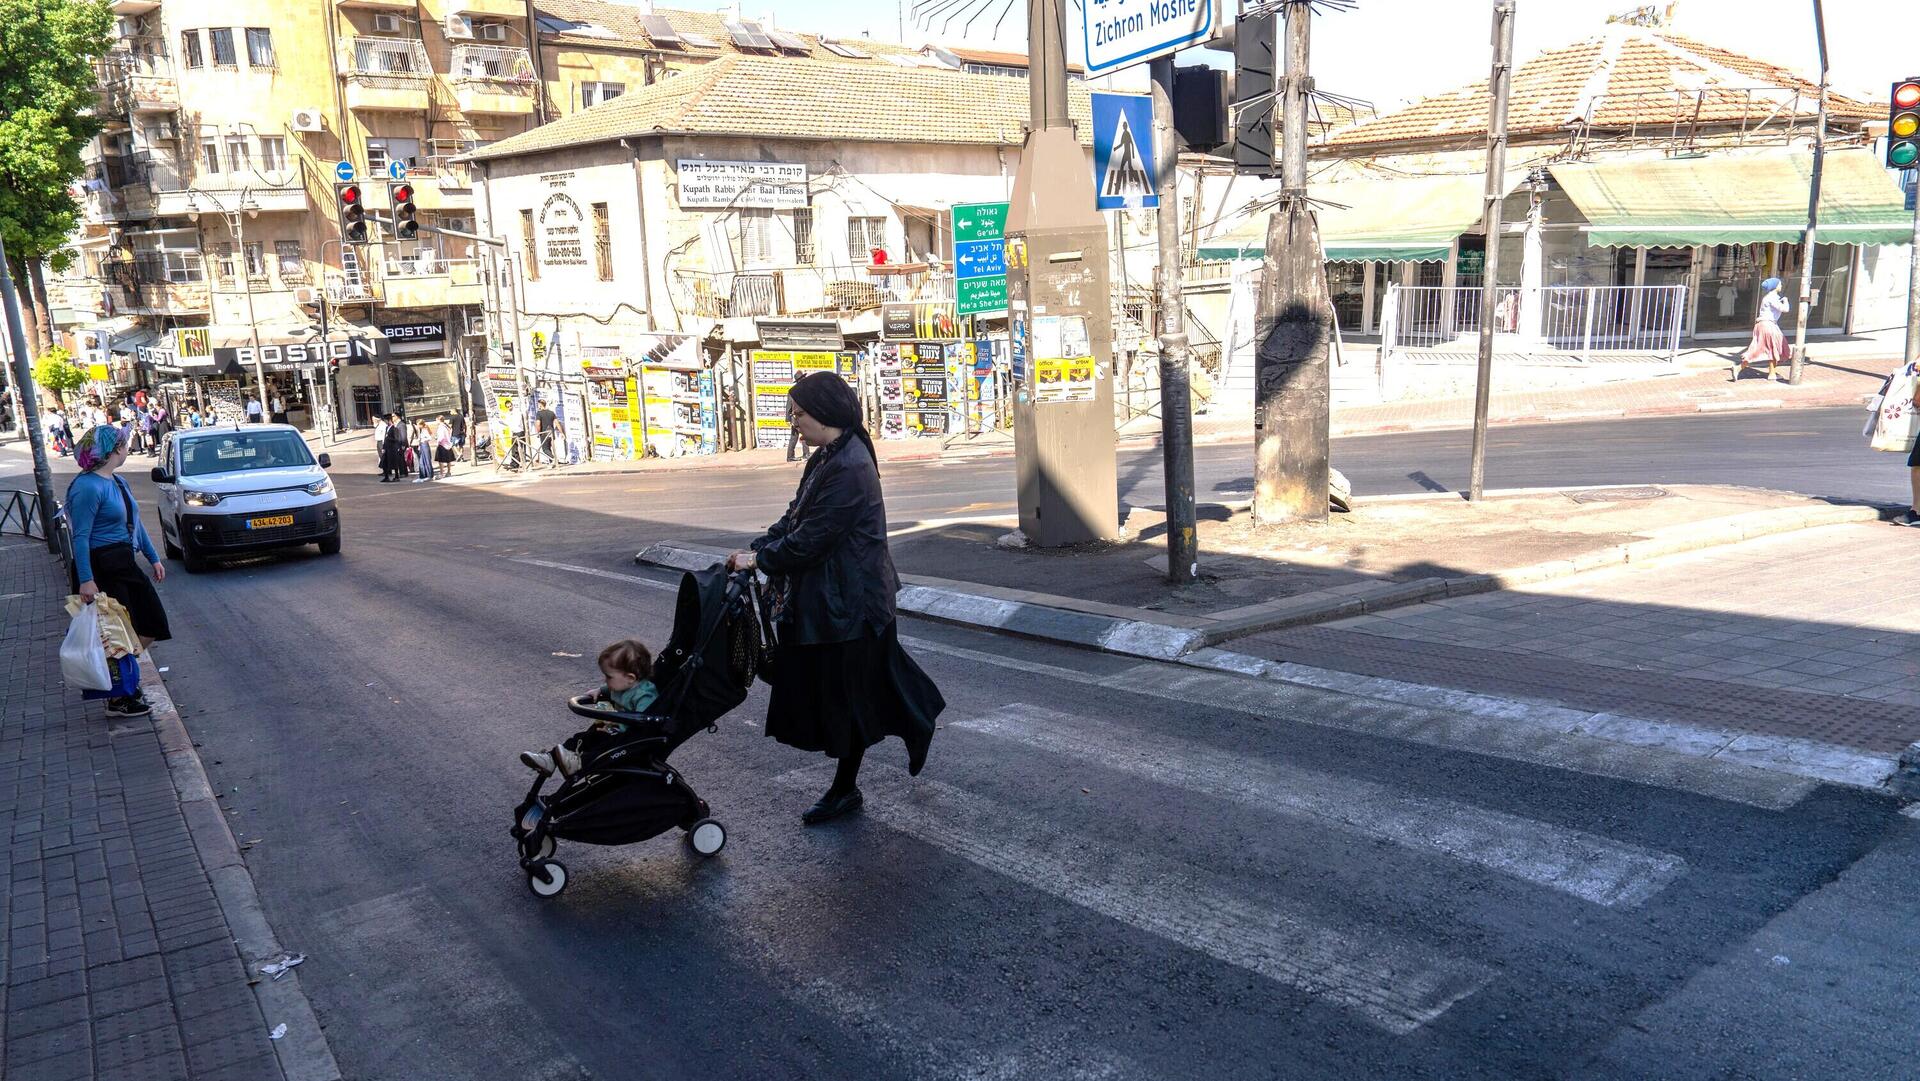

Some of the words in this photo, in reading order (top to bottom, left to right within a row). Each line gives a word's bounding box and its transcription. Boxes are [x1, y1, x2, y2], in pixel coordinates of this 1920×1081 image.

[1095, 12, 1143, 46] Zichron
[1150, 0, 1195, 26] Moshe
[681, 163, 701, 172] הנס
[705, 162, 726, 173] בעל
[730, 165, 755, 174] מאיר
[760, 166, 775, 174] רבי
[779, 166, 803, 176] קופת
[683, 185, 711, 195] Kupath
[715, 185, 736, 194] Rabbi
[759, 186, 775, 194] Baal
[779, 186, 804, 195] Haness
[687, 196, 709, 204] Kupath
[977, 208, 998, 216] גאולה
[977, 228, 999, 237] Ge'ula
[970, 244, 988, 253] אביב
[991, 243, 1002, 251] תל
[987, 264, 1002, 272] Aviv
[963, 280, 988, 289] שערים
[990, 279, 1006, 287] מאה
[960, 300, 977, 309] Me'a
[385, 325, 442, 338] BOSTON
[137, 345, 174, 366] BOST
[236, 339, 378, 365] BOSTON
